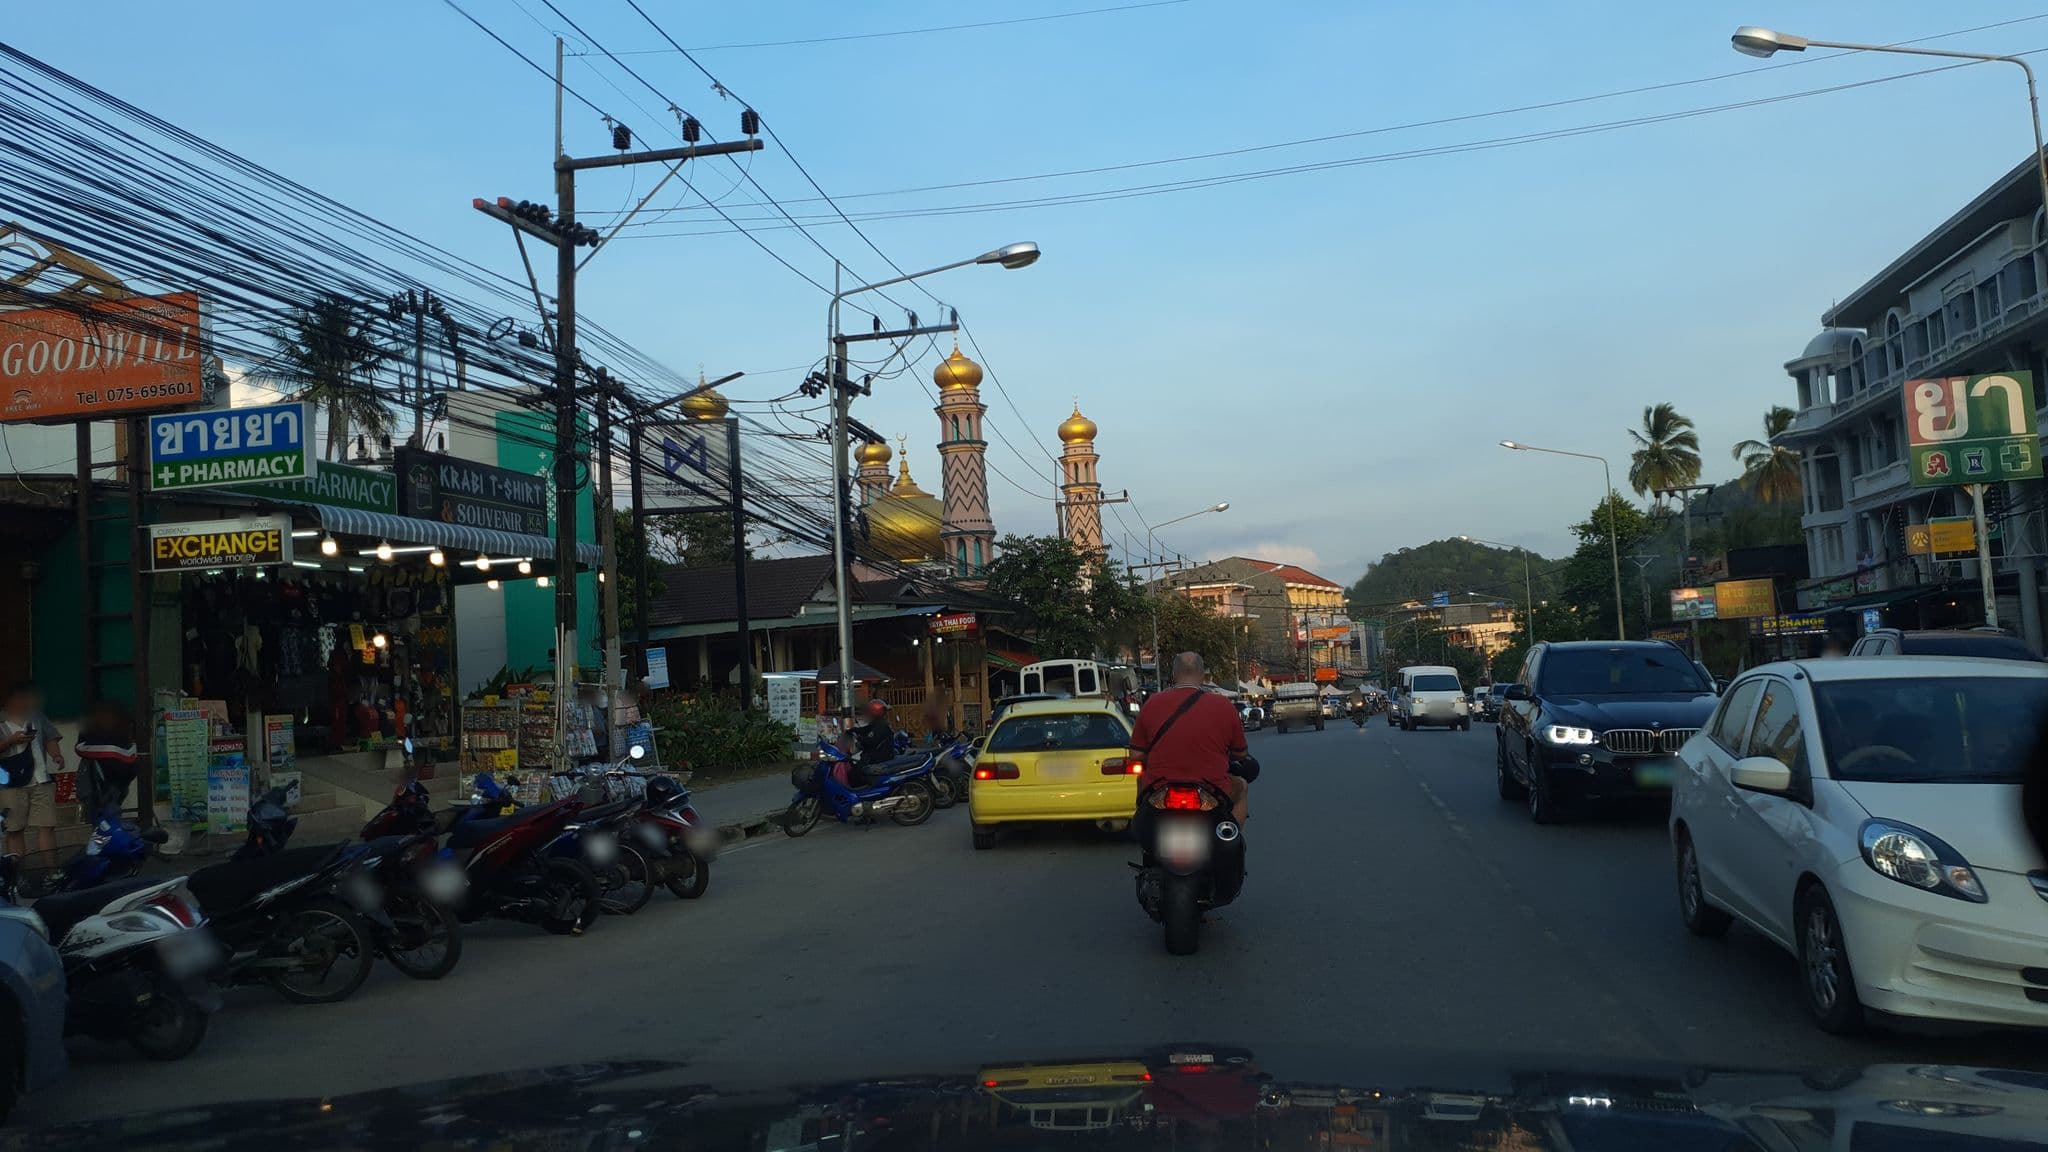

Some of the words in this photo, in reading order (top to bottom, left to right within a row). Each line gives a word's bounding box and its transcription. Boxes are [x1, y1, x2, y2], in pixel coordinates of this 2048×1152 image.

[3, 325, 195, 376] GOODWILL
[77, 392, 102, 405] Tel.
[107, 382, 194, 402] 075-695601
[1914, 376, 2026, 440] ยา
[156, 411, 298, 455] ขายยา
[180, 456, 298, 483] PHARMACY
[440, 464, 484, 494] KRABI
[457, 503, 522, 532] SOUVENIR
[156, 530, 279, 559] EXCHANGE
[180, 555, 222, 566] worldwide
[1762, 618, 1825, 629] EXCHANGE
